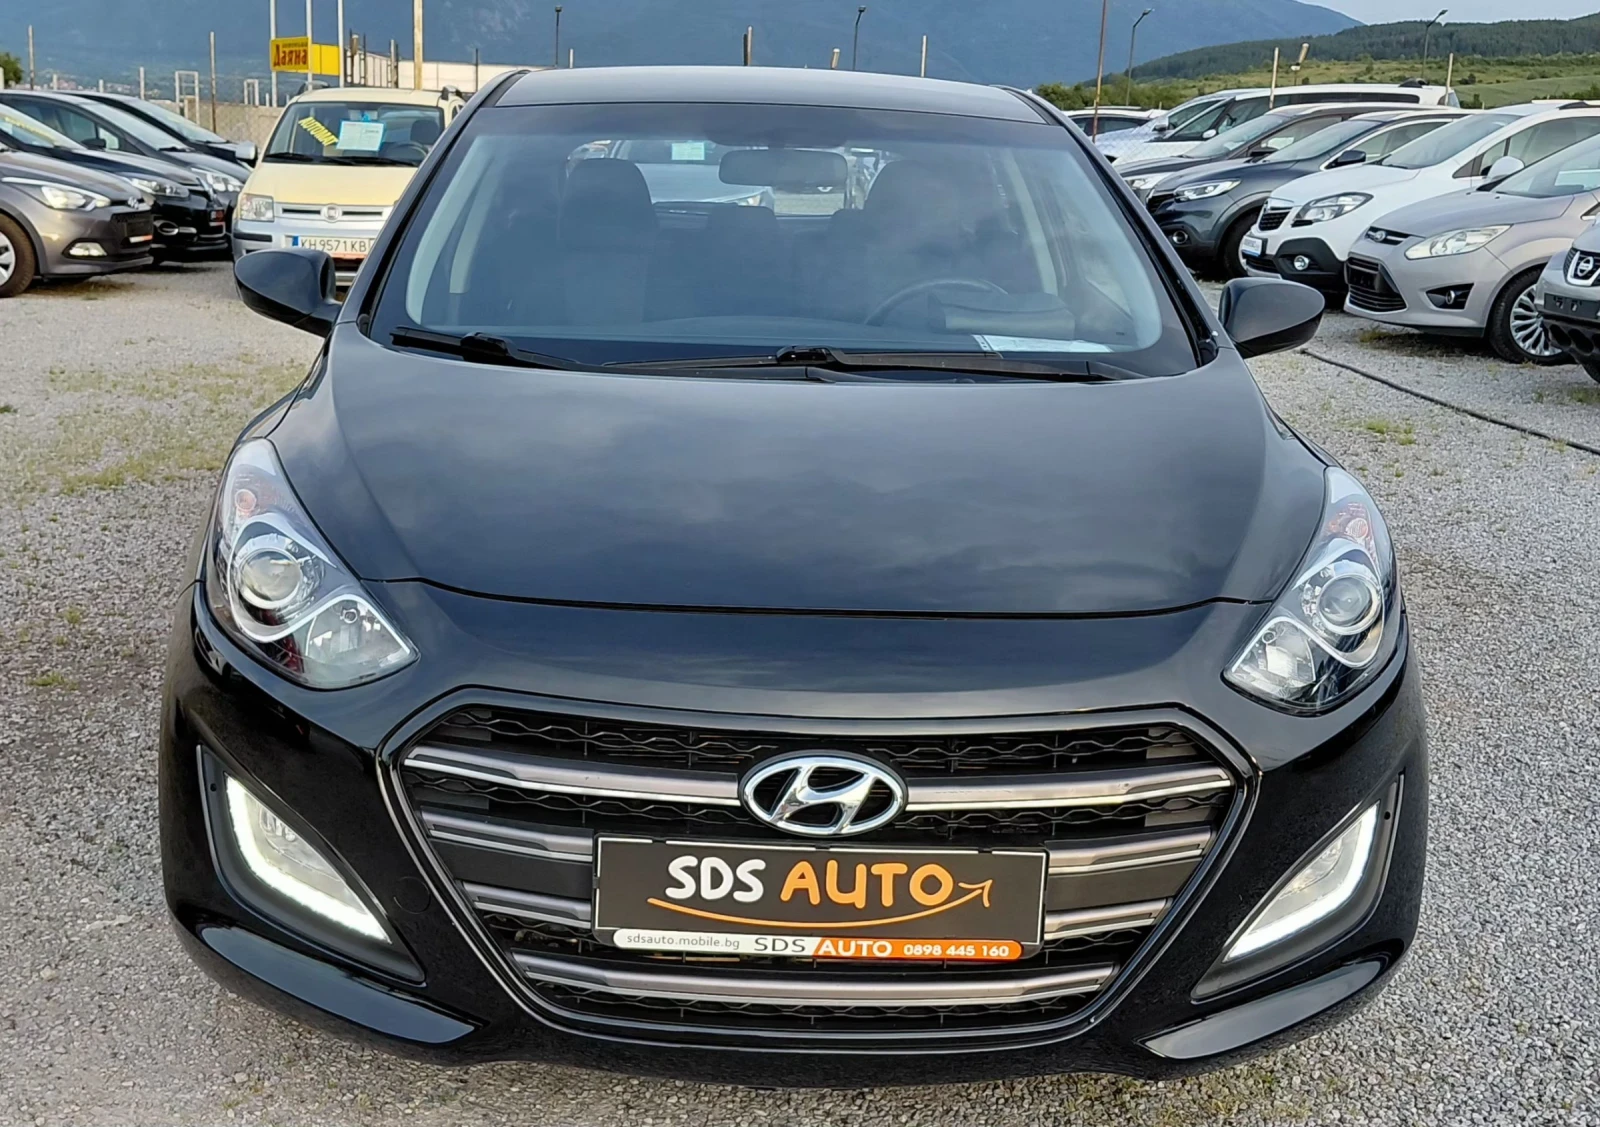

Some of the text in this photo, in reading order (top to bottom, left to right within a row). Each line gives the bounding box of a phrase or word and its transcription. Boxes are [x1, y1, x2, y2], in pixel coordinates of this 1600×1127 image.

[273, 44, 308, 67] Даяна
[665, 855, 954, 909] SDS AUTO
[627, 933, 1010, 958] sdsauto.mobile.bg SDS AUTO 0898 445 160
